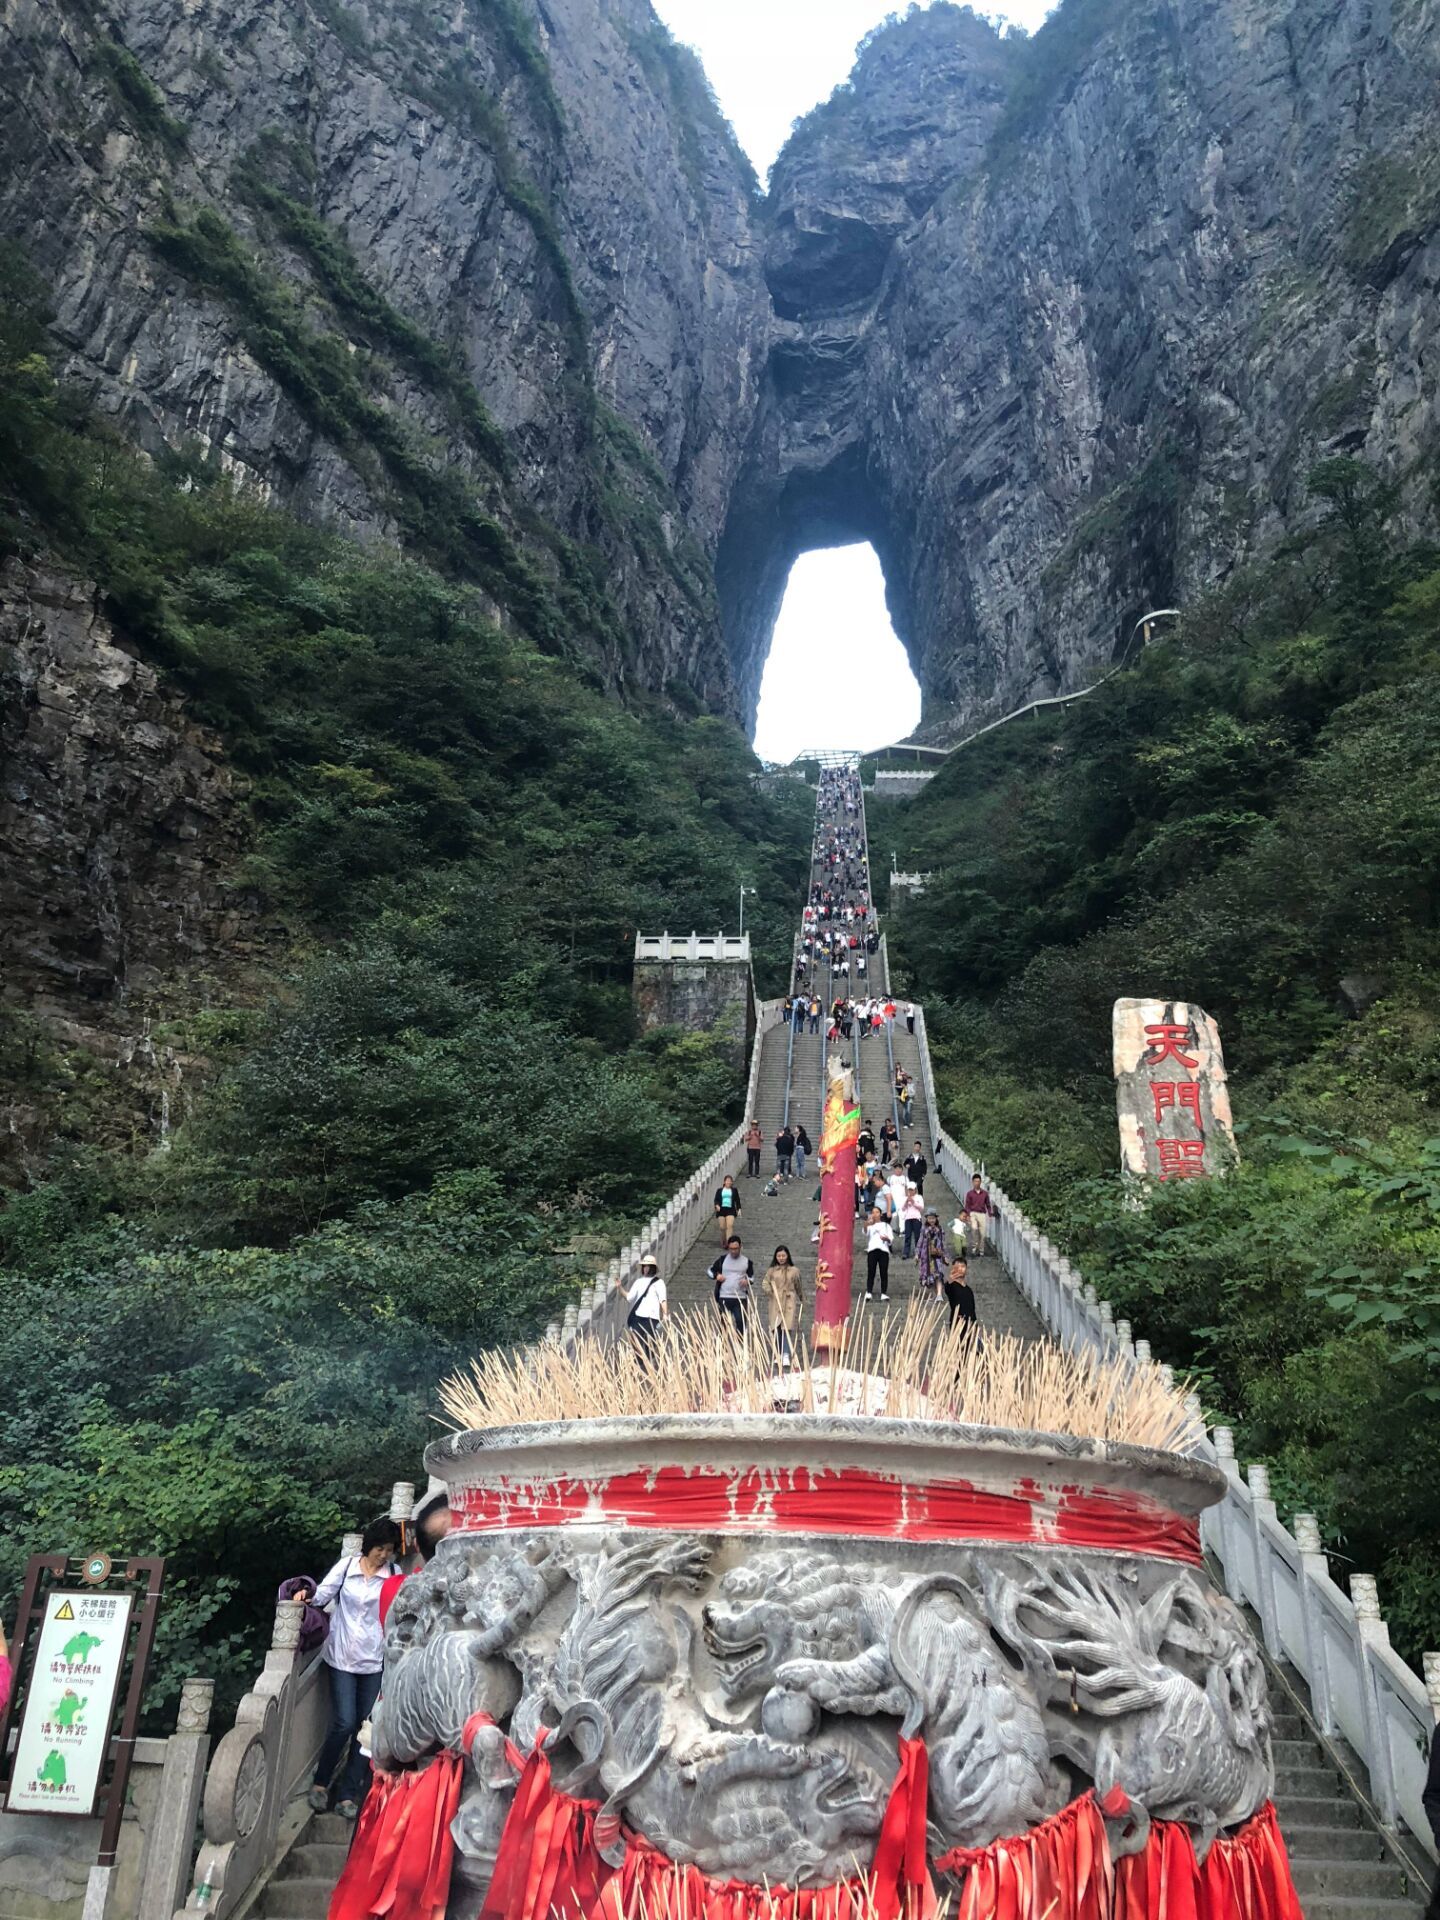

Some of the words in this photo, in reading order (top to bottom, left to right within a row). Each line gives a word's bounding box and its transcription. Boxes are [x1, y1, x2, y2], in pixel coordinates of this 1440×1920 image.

[79, 1609, 115, 1618] 小心缓行
[53, 1676, 62, 1684] No
[65, 1677, 94, 1686] Climbing
[56, 1737, 83, 1745] Running
